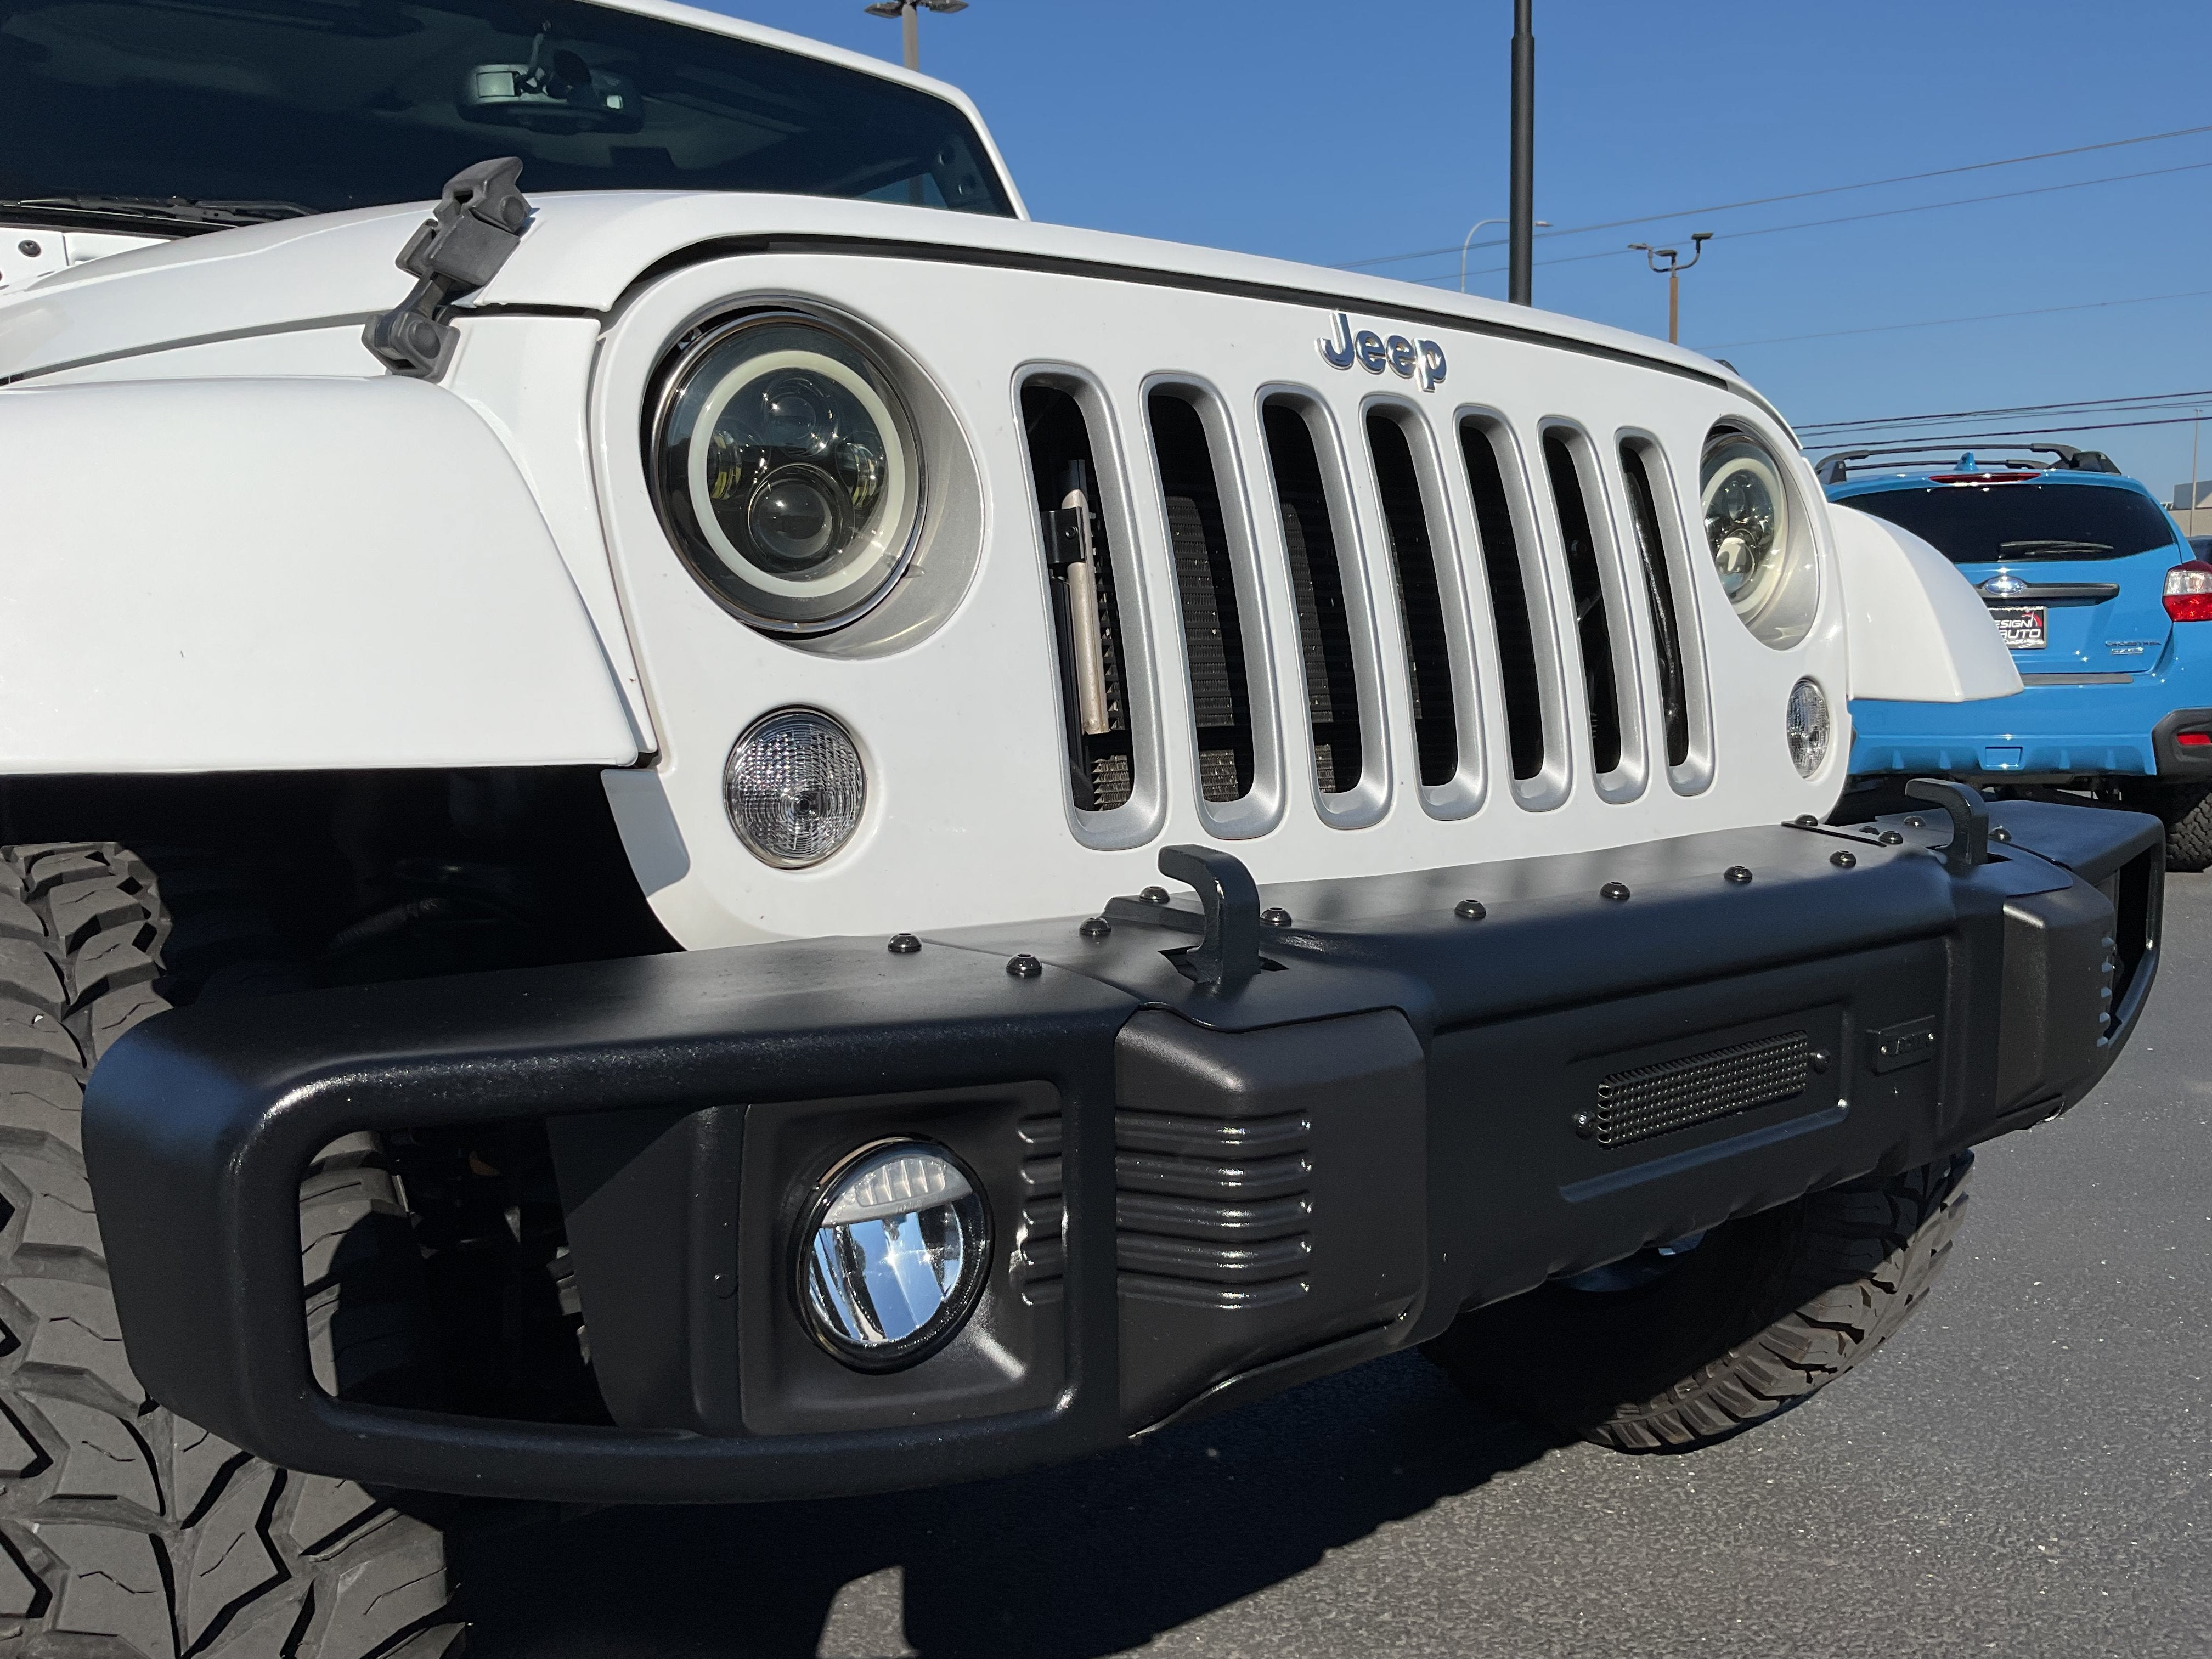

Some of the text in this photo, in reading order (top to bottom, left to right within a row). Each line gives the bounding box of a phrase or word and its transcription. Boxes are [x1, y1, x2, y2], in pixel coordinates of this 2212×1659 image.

[1316, 311, 1447, 393] Jeep
[1994, 619, 2030, 628] ESIGN
[2000, 629, 2041, 639] AUTO
